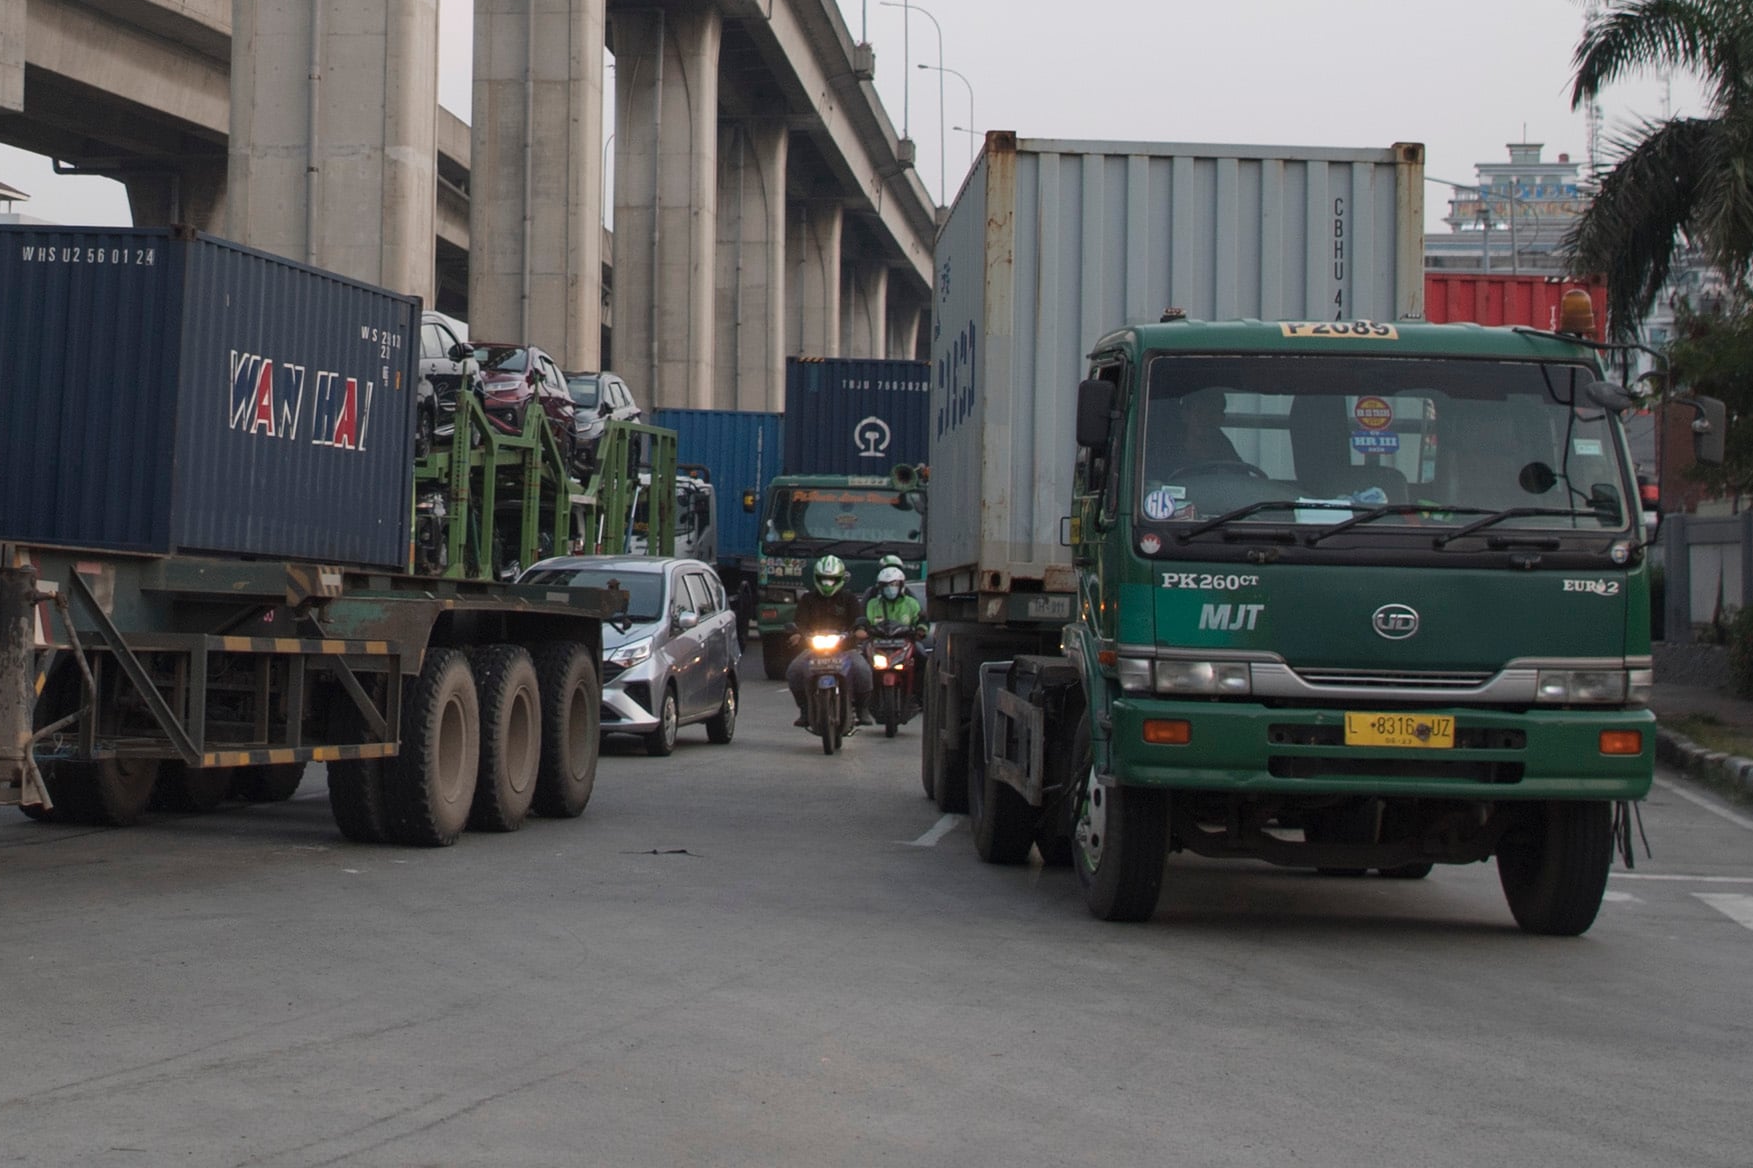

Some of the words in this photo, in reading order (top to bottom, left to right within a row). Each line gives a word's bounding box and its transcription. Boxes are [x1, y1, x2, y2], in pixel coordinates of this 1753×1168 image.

[1334, 198, 1343, 281] CBHU
[229, 349, 305, 441] WAN
[312, 371, 374, 452] HAI
[1354, 436, 1377, 447] HR
[1199, 603, 1265, 631] MJT
[1376, 613, 1416, 631] UD
[1348, 716, 1358, 734] L
[1376, 716, 1416, 736] 8316
[1431, 718, 1451, 737] UZ
